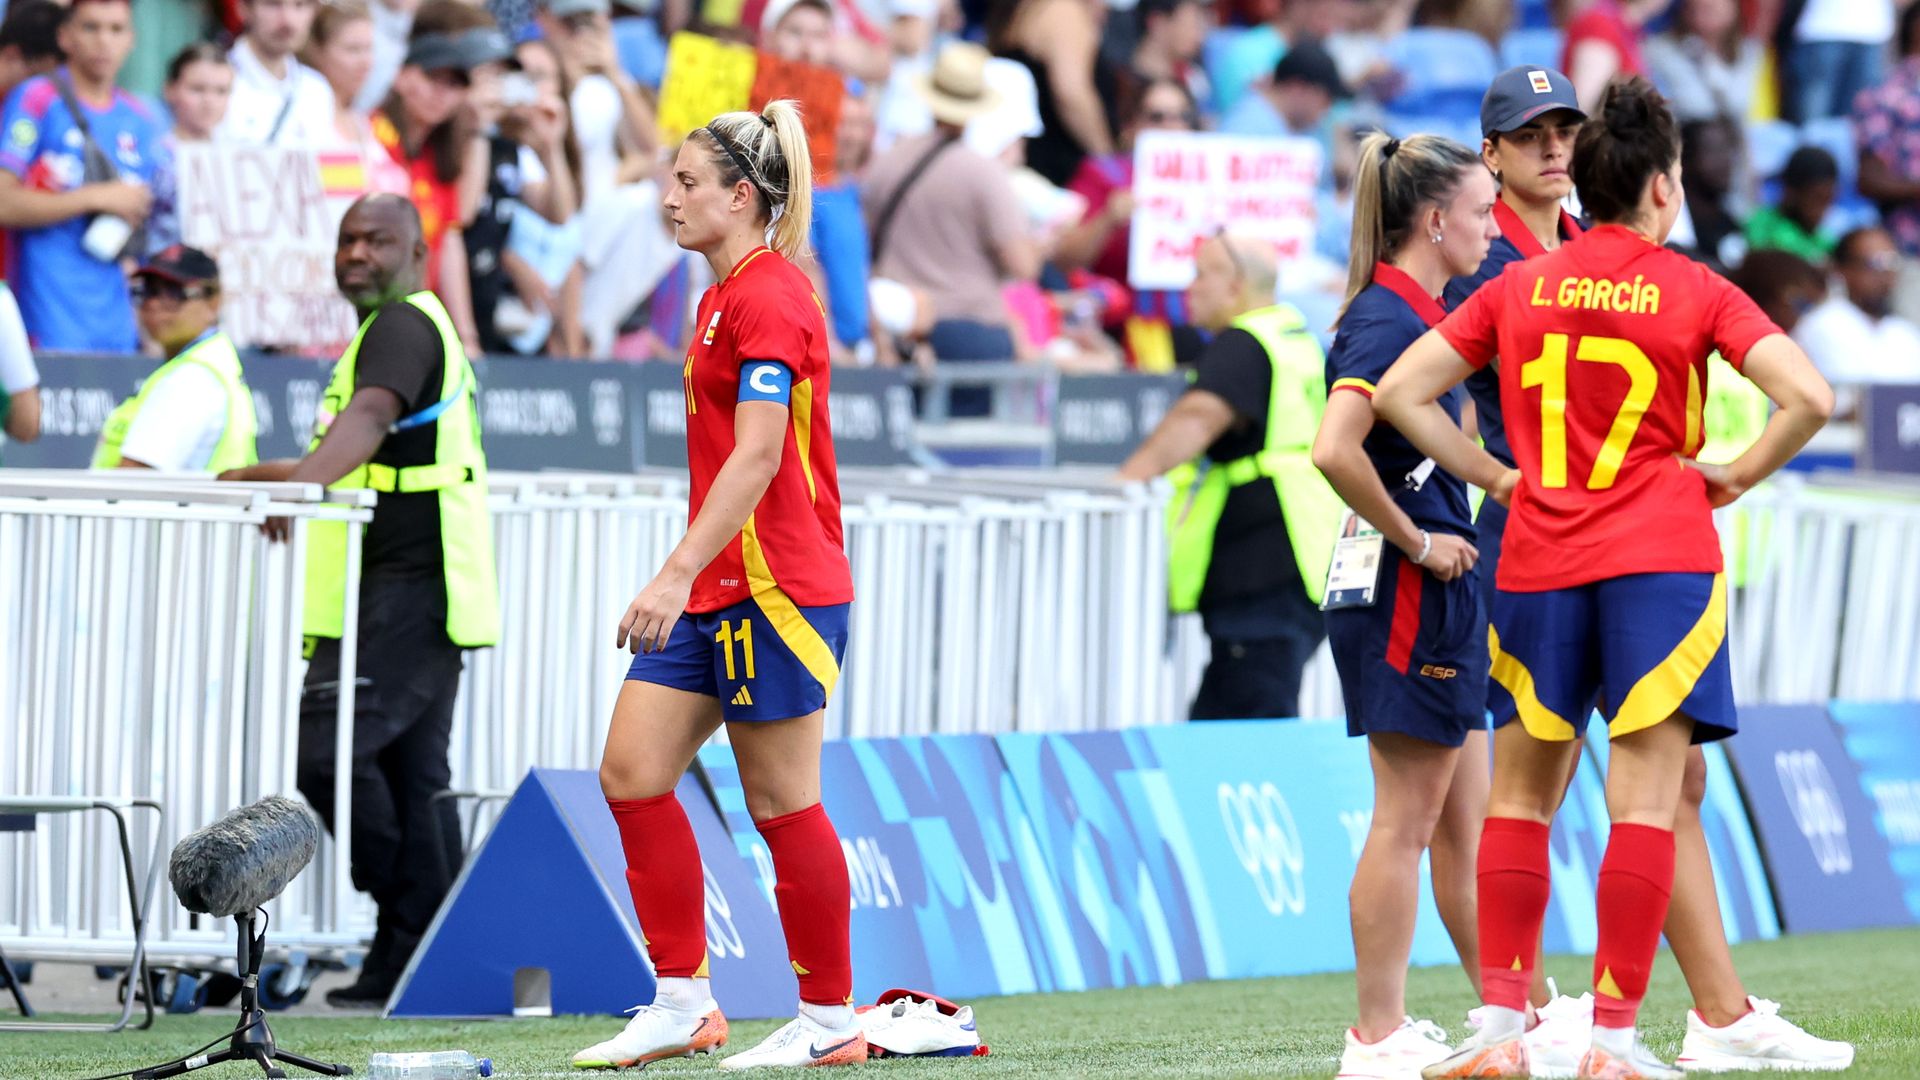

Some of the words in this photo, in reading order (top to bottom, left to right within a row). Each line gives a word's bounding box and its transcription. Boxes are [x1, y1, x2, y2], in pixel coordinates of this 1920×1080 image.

[1531, 276, 1552, 306] L.
[1557, 275, 1660, 314] GARCÍA
[749, 365, 782, 394] C
[1521, 333, 1659, 490] 17
[715, 618, 755, 680] 11
[1419, 664, 1457, 680] ESP
[841, 836, 903, 910] 024
